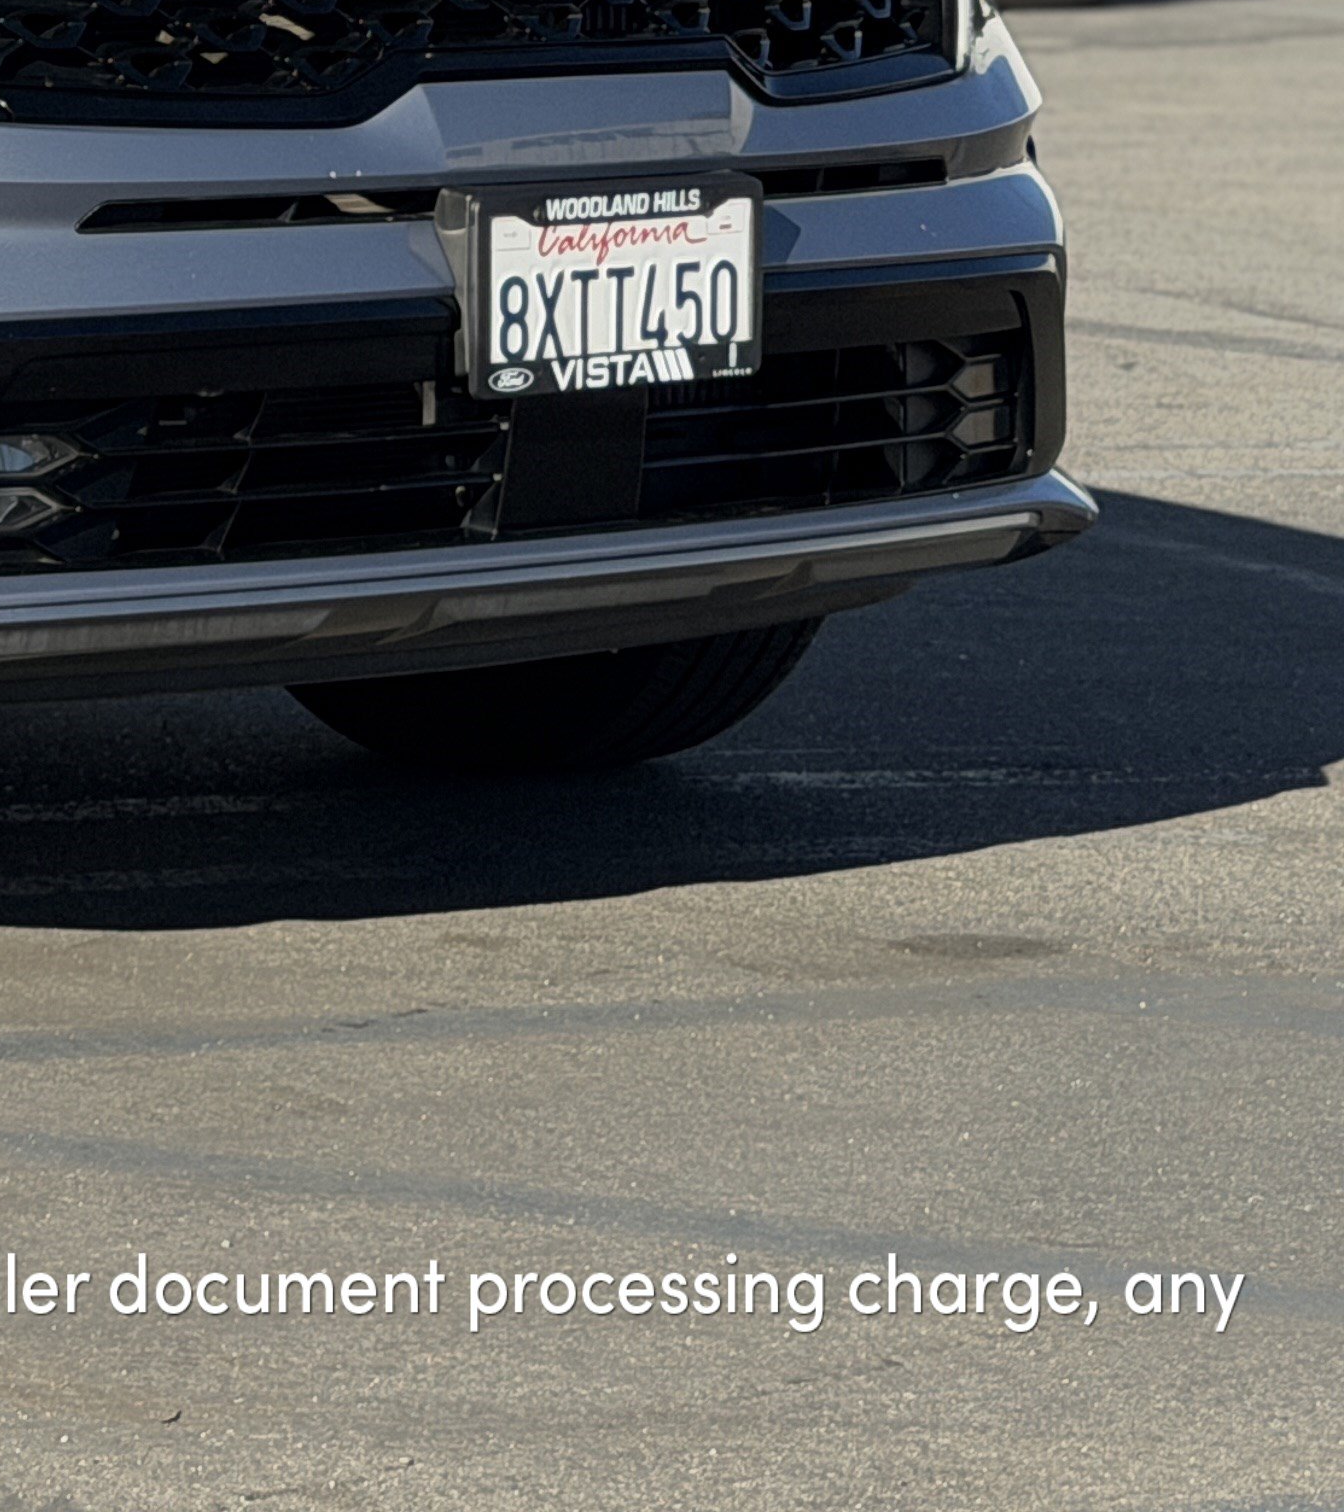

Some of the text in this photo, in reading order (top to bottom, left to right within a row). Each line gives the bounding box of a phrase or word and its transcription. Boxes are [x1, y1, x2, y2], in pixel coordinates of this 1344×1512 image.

[545, 188, 702, 221] WOODLAND HILLS
[537, 221, 708, 266] California
[499, 259, 738, 363] 8XTT450
[551, 350, 656, 392] VISTA
